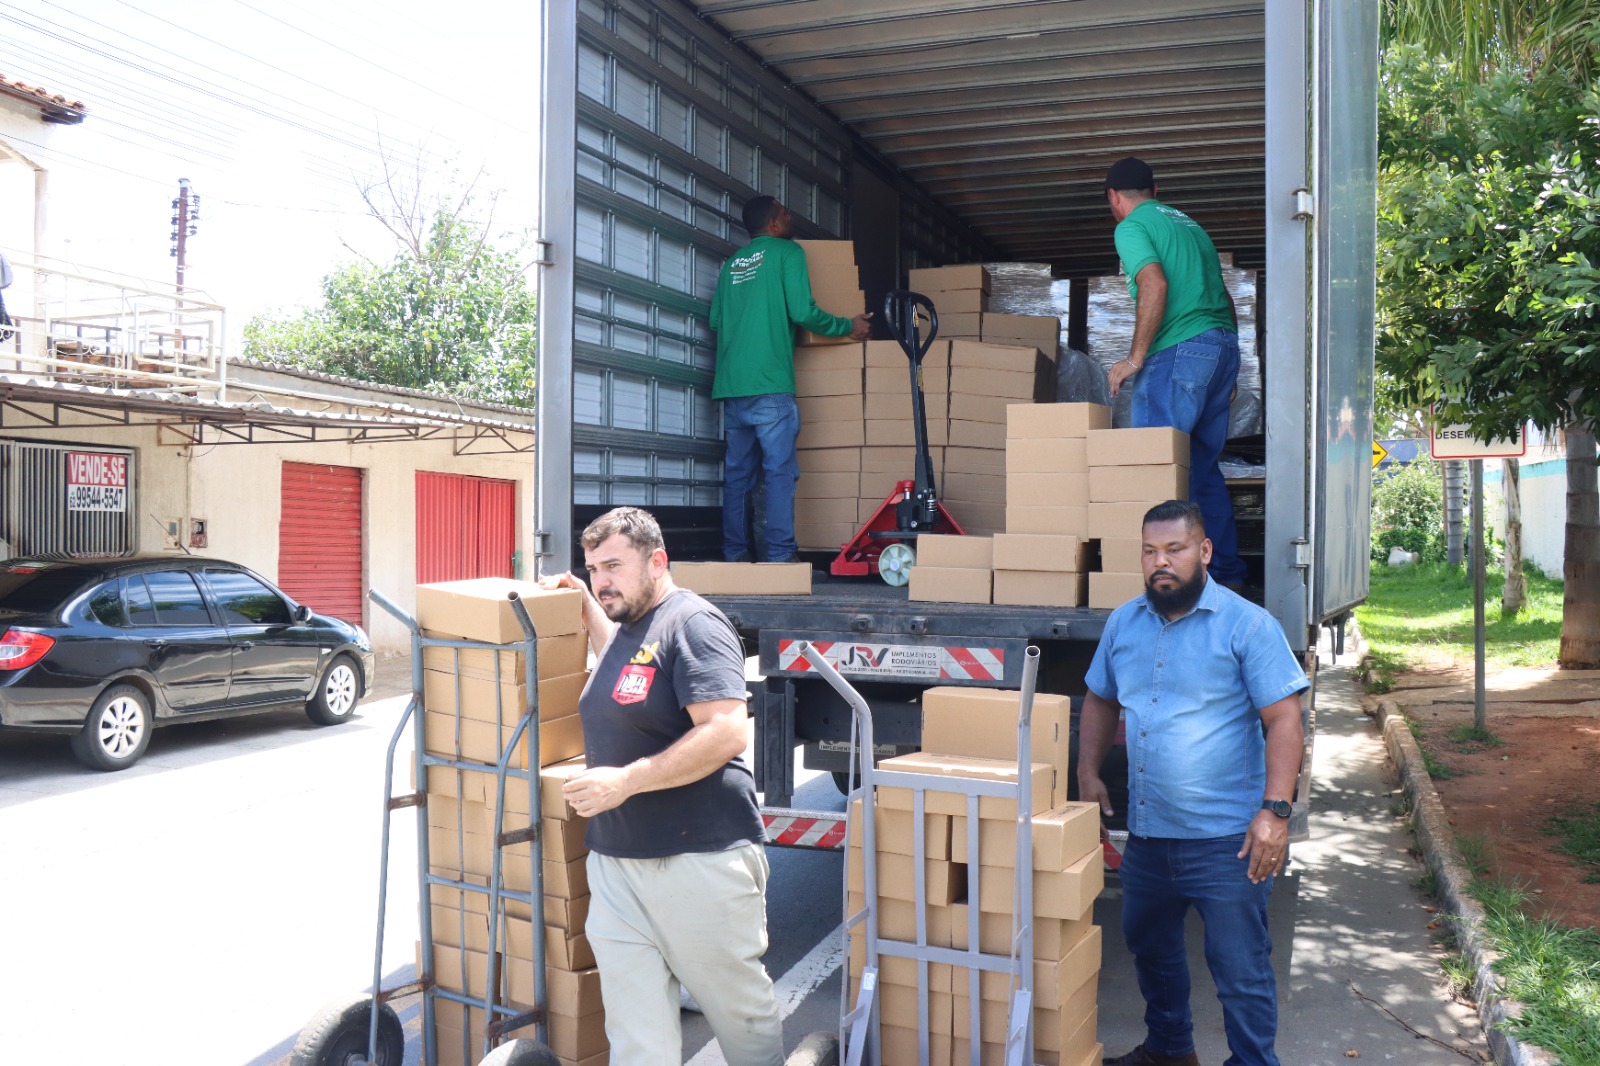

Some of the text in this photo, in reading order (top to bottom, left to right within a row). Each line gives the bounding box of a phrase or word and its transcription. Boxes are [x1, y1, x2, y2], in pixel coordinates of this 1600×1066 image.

[70, 454, 125, 485] VENDE-SE
[76, 486, 123, 509] 99544-5547
[891, 651, 937, 659] IMPLEMENTOS
